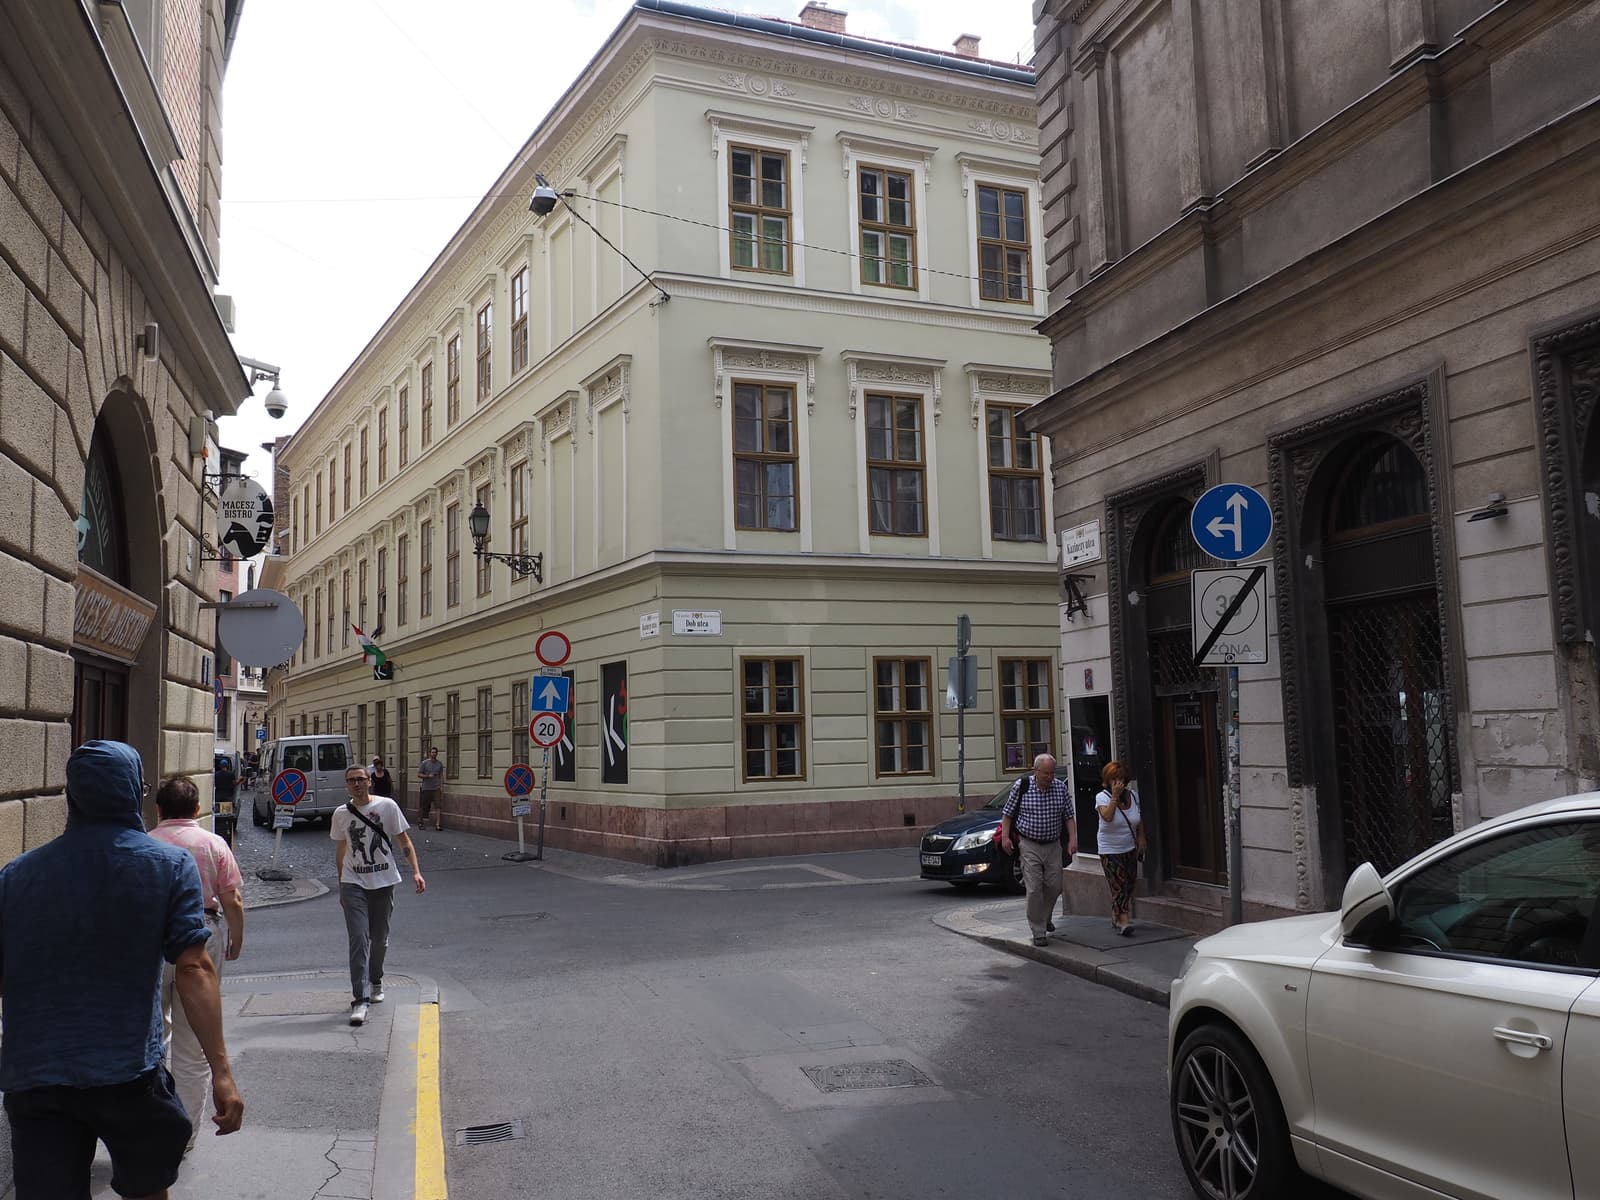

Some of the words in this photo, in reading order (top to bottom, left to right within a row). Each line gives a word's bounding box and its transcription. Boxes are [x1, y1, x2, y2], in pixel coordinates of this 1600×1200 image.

[222, 501, 255, 510] MACESZ
[224, 510, 253, 519] BISTRO
[111, 604, 149, 652] BISTRO
[685, 619, 695, 628] Dob
[697, 620, 709, 628] utca
[257, 730, 264, 738] P
[538, 722, 556, 737] 20
